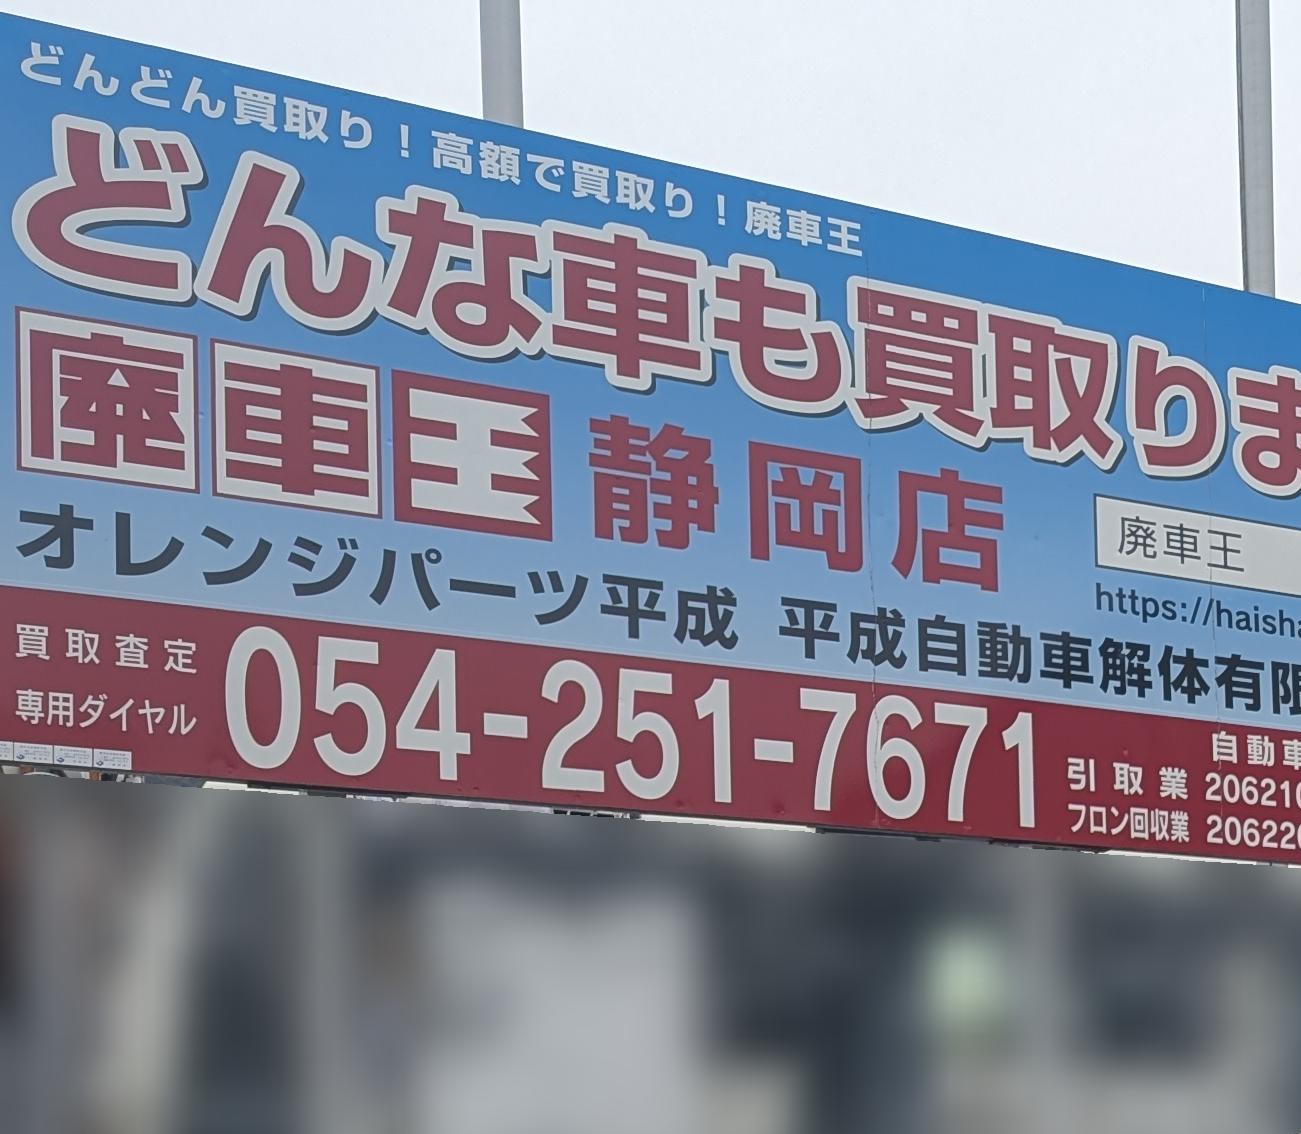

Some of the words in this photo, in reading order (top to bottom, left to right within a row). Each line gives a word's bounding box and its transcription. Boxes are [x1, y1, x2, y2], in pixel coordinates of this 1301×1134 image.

[1118, 516, 1245, 573] 廃車王
[16, 503, 739, 650] オレンジパーツ平成
[15, 623, 197, 674] 買取査定
[15, 689, 197, 736] 専用ダイヤル
[225, 625, 1036, 829] 054-251-7671
[1067, 757, 1188, 800] 引取業
[1067, 804, 1189, 843] フロン回収業
